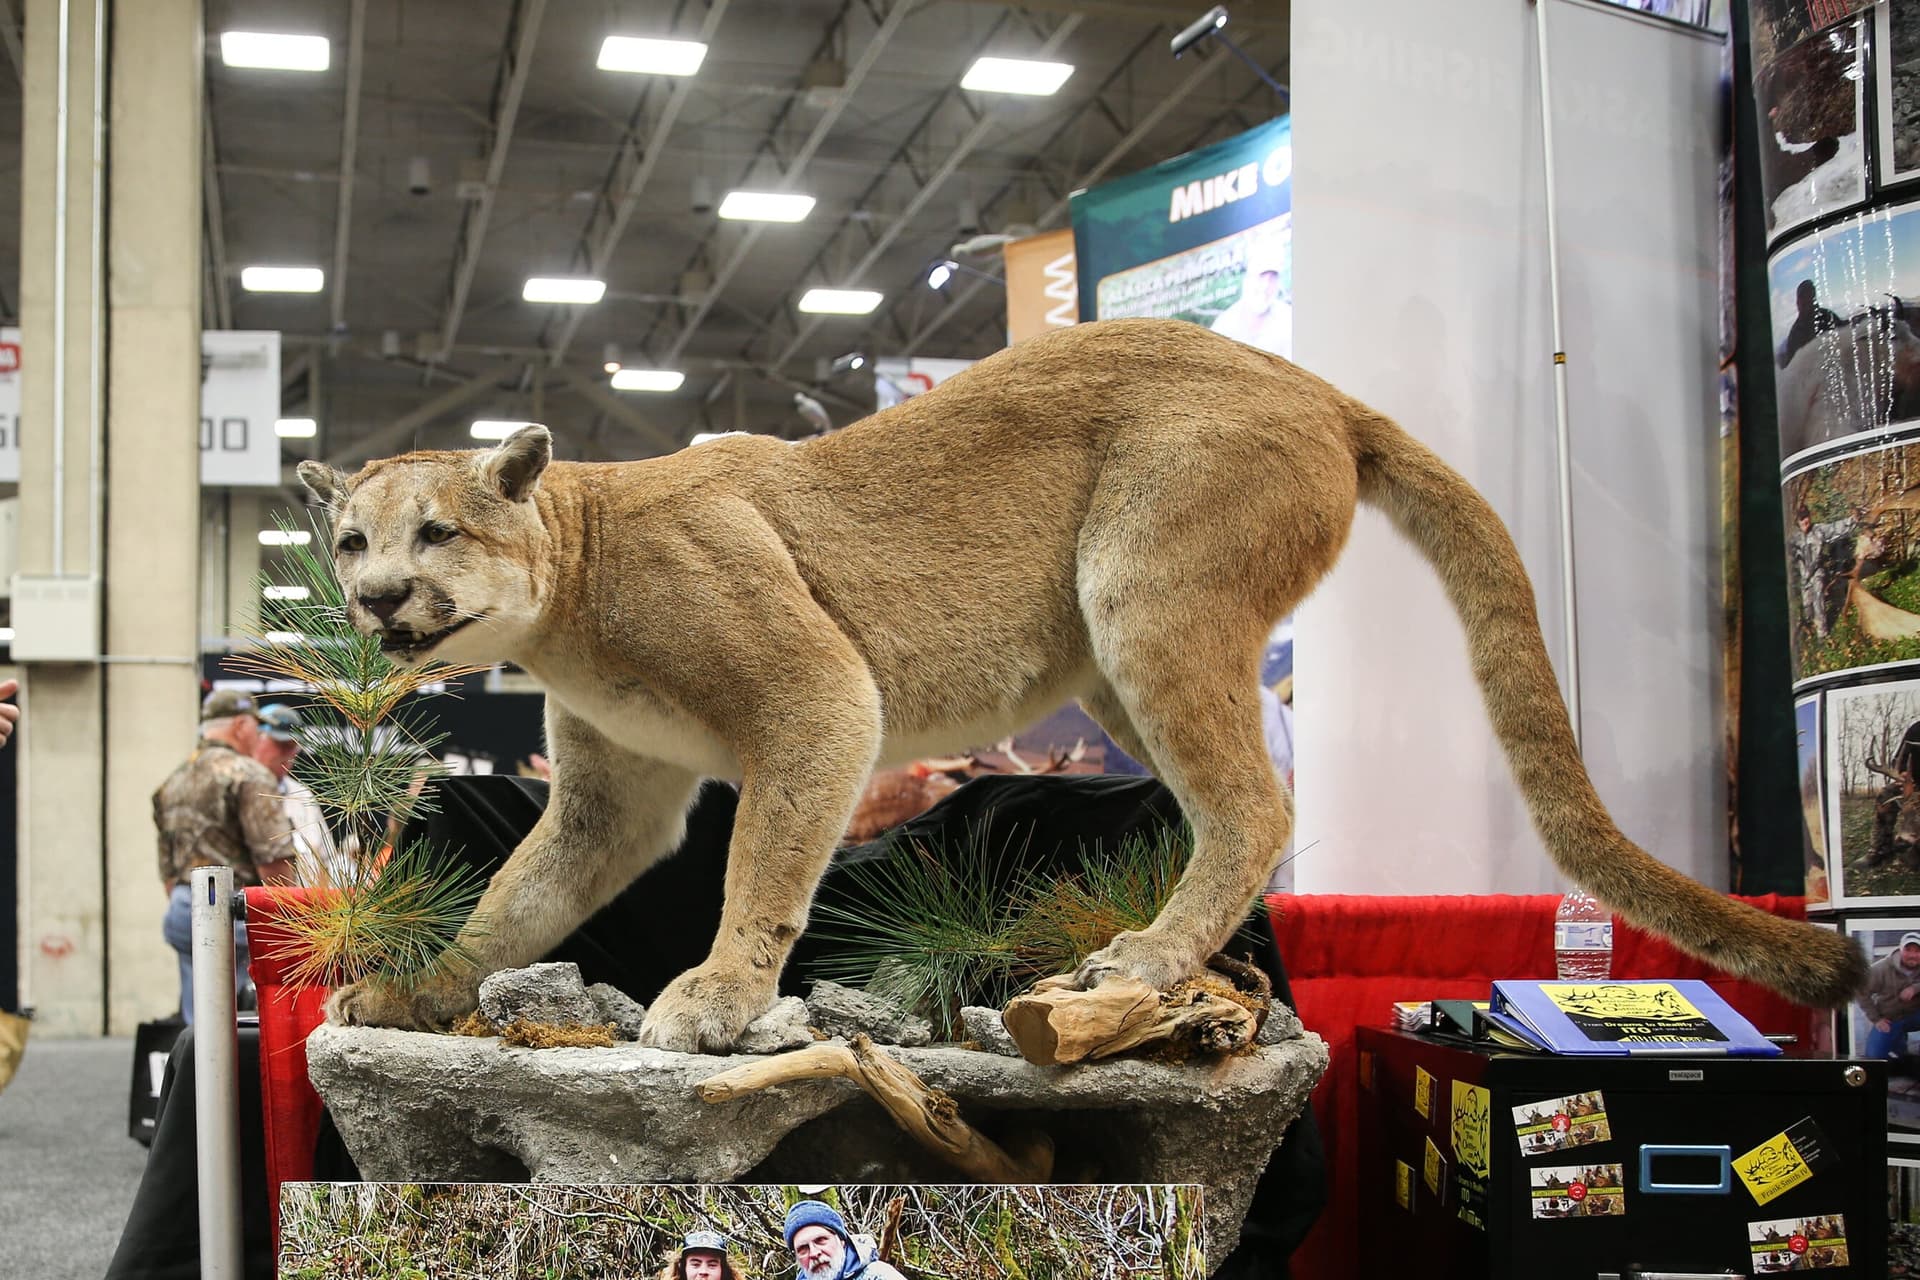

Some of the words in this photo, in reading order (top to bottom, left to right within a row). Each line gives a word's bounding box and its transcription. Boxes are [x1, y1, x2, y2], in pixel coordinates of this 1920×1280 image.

[1169, 162, 1259, 223] MIKE
[1760, 1183, 1782, 1199] Frank
[1780, 1174, 1801, 1188] Smith
